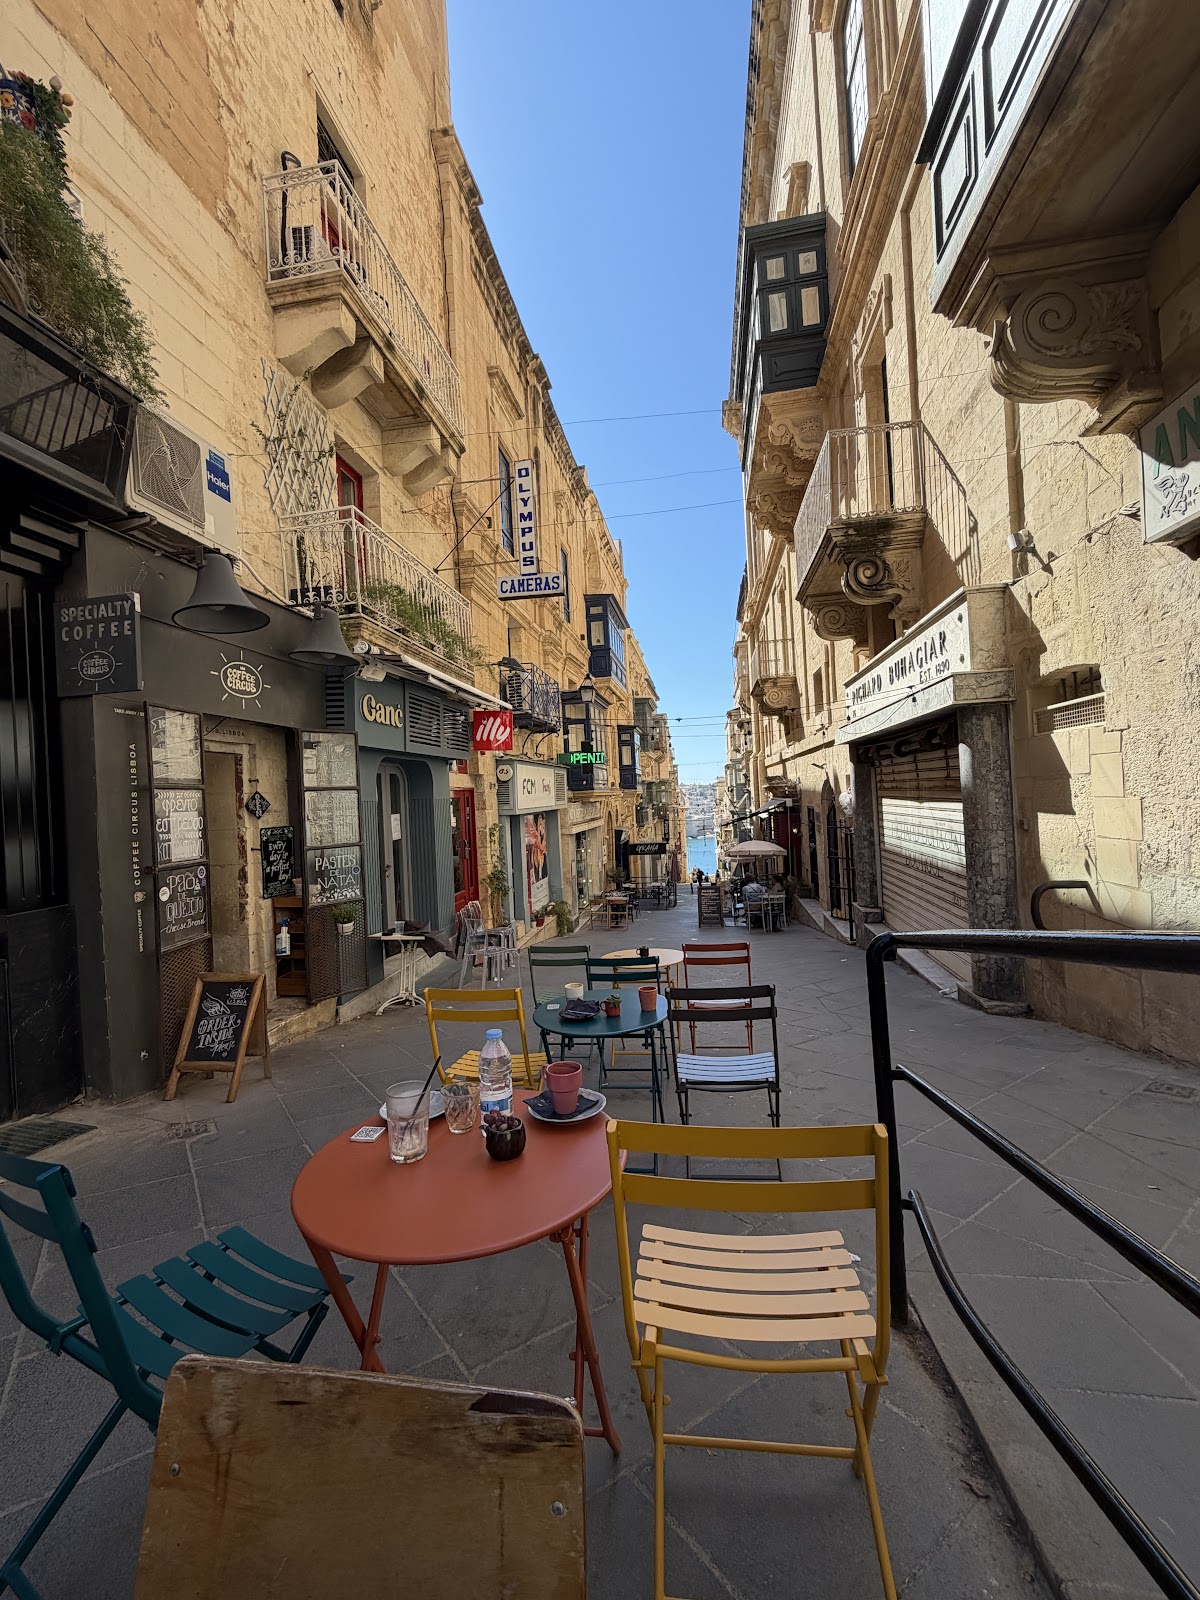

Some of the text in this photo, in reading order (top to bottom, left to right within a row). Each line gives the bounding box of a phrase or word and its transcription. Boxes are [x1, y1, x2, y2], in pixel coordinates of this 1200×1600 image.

[206, 470, 230, 492] Haier
[517, 466, 535, 567] OLYMPUS
[500, 575, 561, 594] CAMERAS
[60, 600, 131, 622] SPECIALTY
[61, 620, 132, 641] COFFEE
[82, 658, 109, 667] COFFEE
[82, 664, 109, 675] CIRCUS
[851, 630, 948, 706] RICHARD BUHAGIAR
[227, 667, 256, 683] COFFEE
[227, 677, 257, 692] CIRCUS
[475, 716, 511, 748] illy
[128, 743, 141, 886] COFFEE CIRCUS LISBOA
[317, 874, 356, 889] NATA
[197, 1014, 241, 1035] ORDER
[195, 1027, 235, 1049] INSIDE
